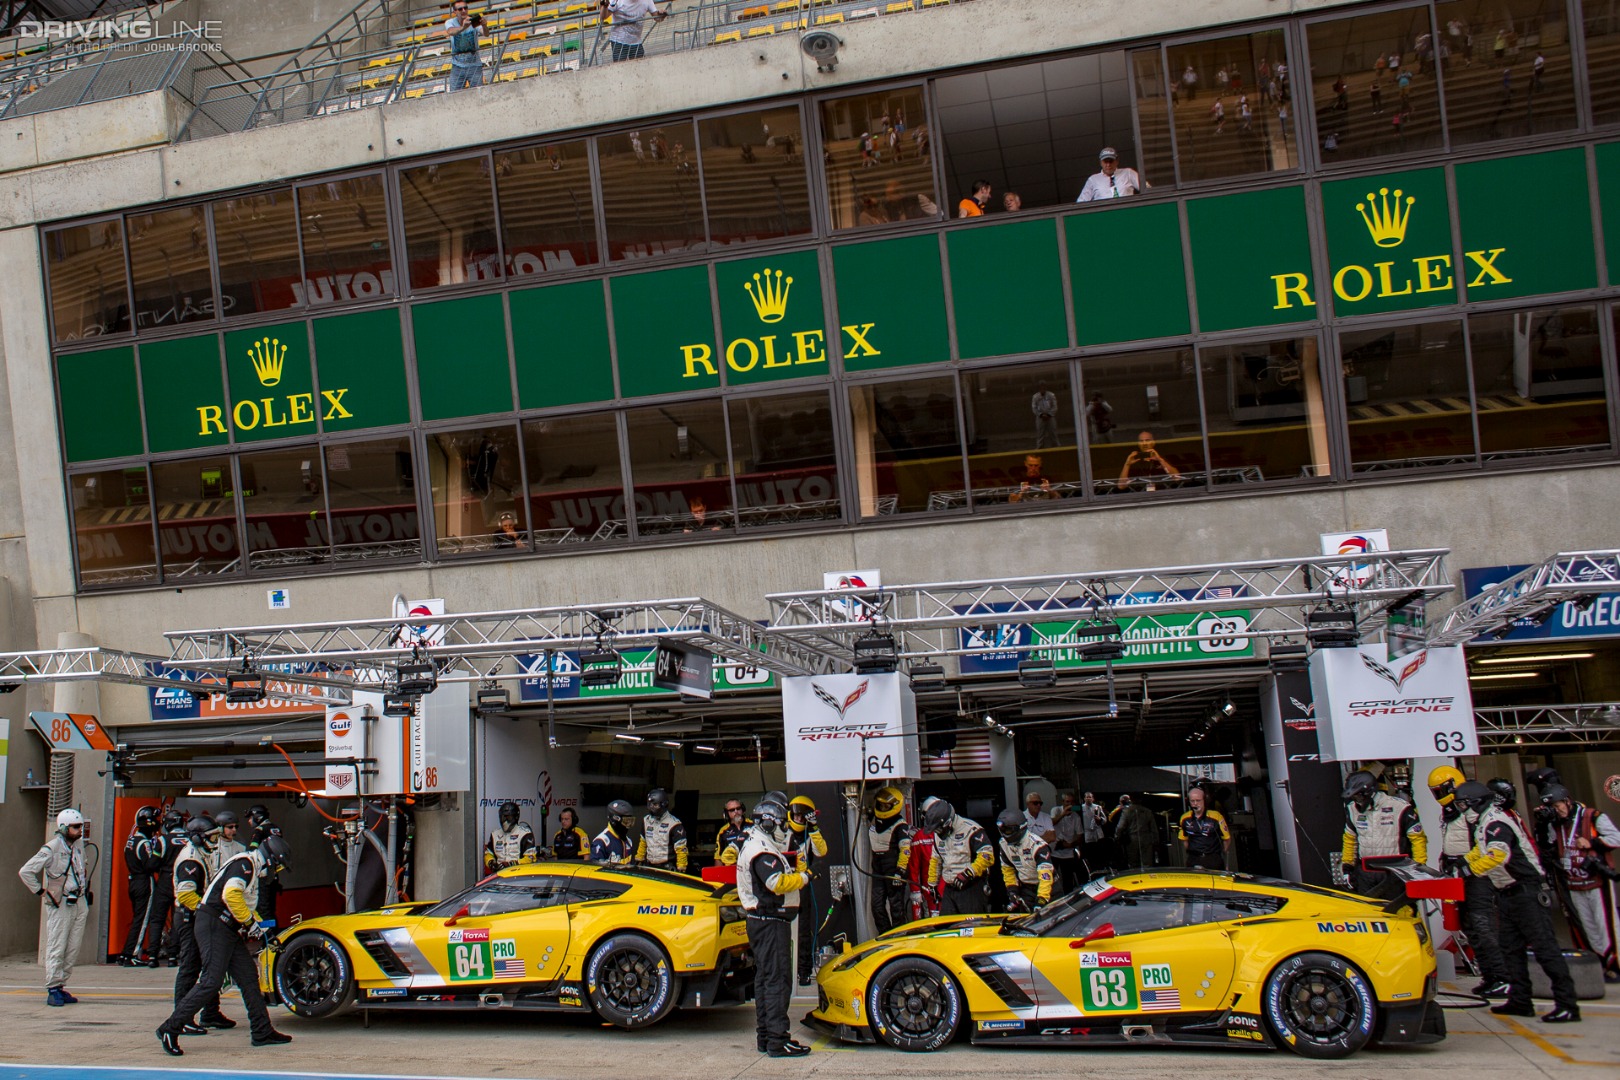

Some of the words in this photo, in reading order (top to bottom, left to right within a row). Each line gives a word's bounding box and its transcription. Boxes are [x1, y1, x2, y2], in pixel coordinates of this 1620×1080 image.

[1270, 247, 1513, 310] ROLEX
[680, 323, 881, 378] ROLEX
[197, 388, 353, 436] ROLEX
[1122, 625, 1193, 656] CORVETTE
[1208, 621, 1237, 649] 63
[657, 650, 671, 677] 64
[154, 698, 166, 706] LE
[166, 696, 193, 705] MANS
[1347, 705, 1452, 717] RACING
[1348, 696, 1455, 708] CORVETTE
[50, 718, 72, 743] 86
[330, 719, 351, 730] Gulf
[798, 722, 888, 734] CORVETTE
[797, 730, 886, 742] RACING
[1433, 731, 1466, 753] 63
[867, 754, 895, 775] 64
[425, 766, 438, 788] 86
[553, 798, 578, 807] MADE
[637, 905, 677, 915] Mobil
[463, 931, 488, 939] TOTAL
[1317, 921, 1368, 933] Mobil
[493, 941, 515, 958] PRO
[1099, 955, 1131, 963] TOTAL
[454, 943, 485, 979] 64
[589, 944, 610, 978] MICHELIN
[1142, 967, 1171, 985] PRO
[651, 975, 669, 1013] MICHELIN
[1089, 969, 1129, 1008] 63
[1269, 983, 1285, 1031] MICHELIN
[1356, 983, 1373, 1031] MICHELIN
